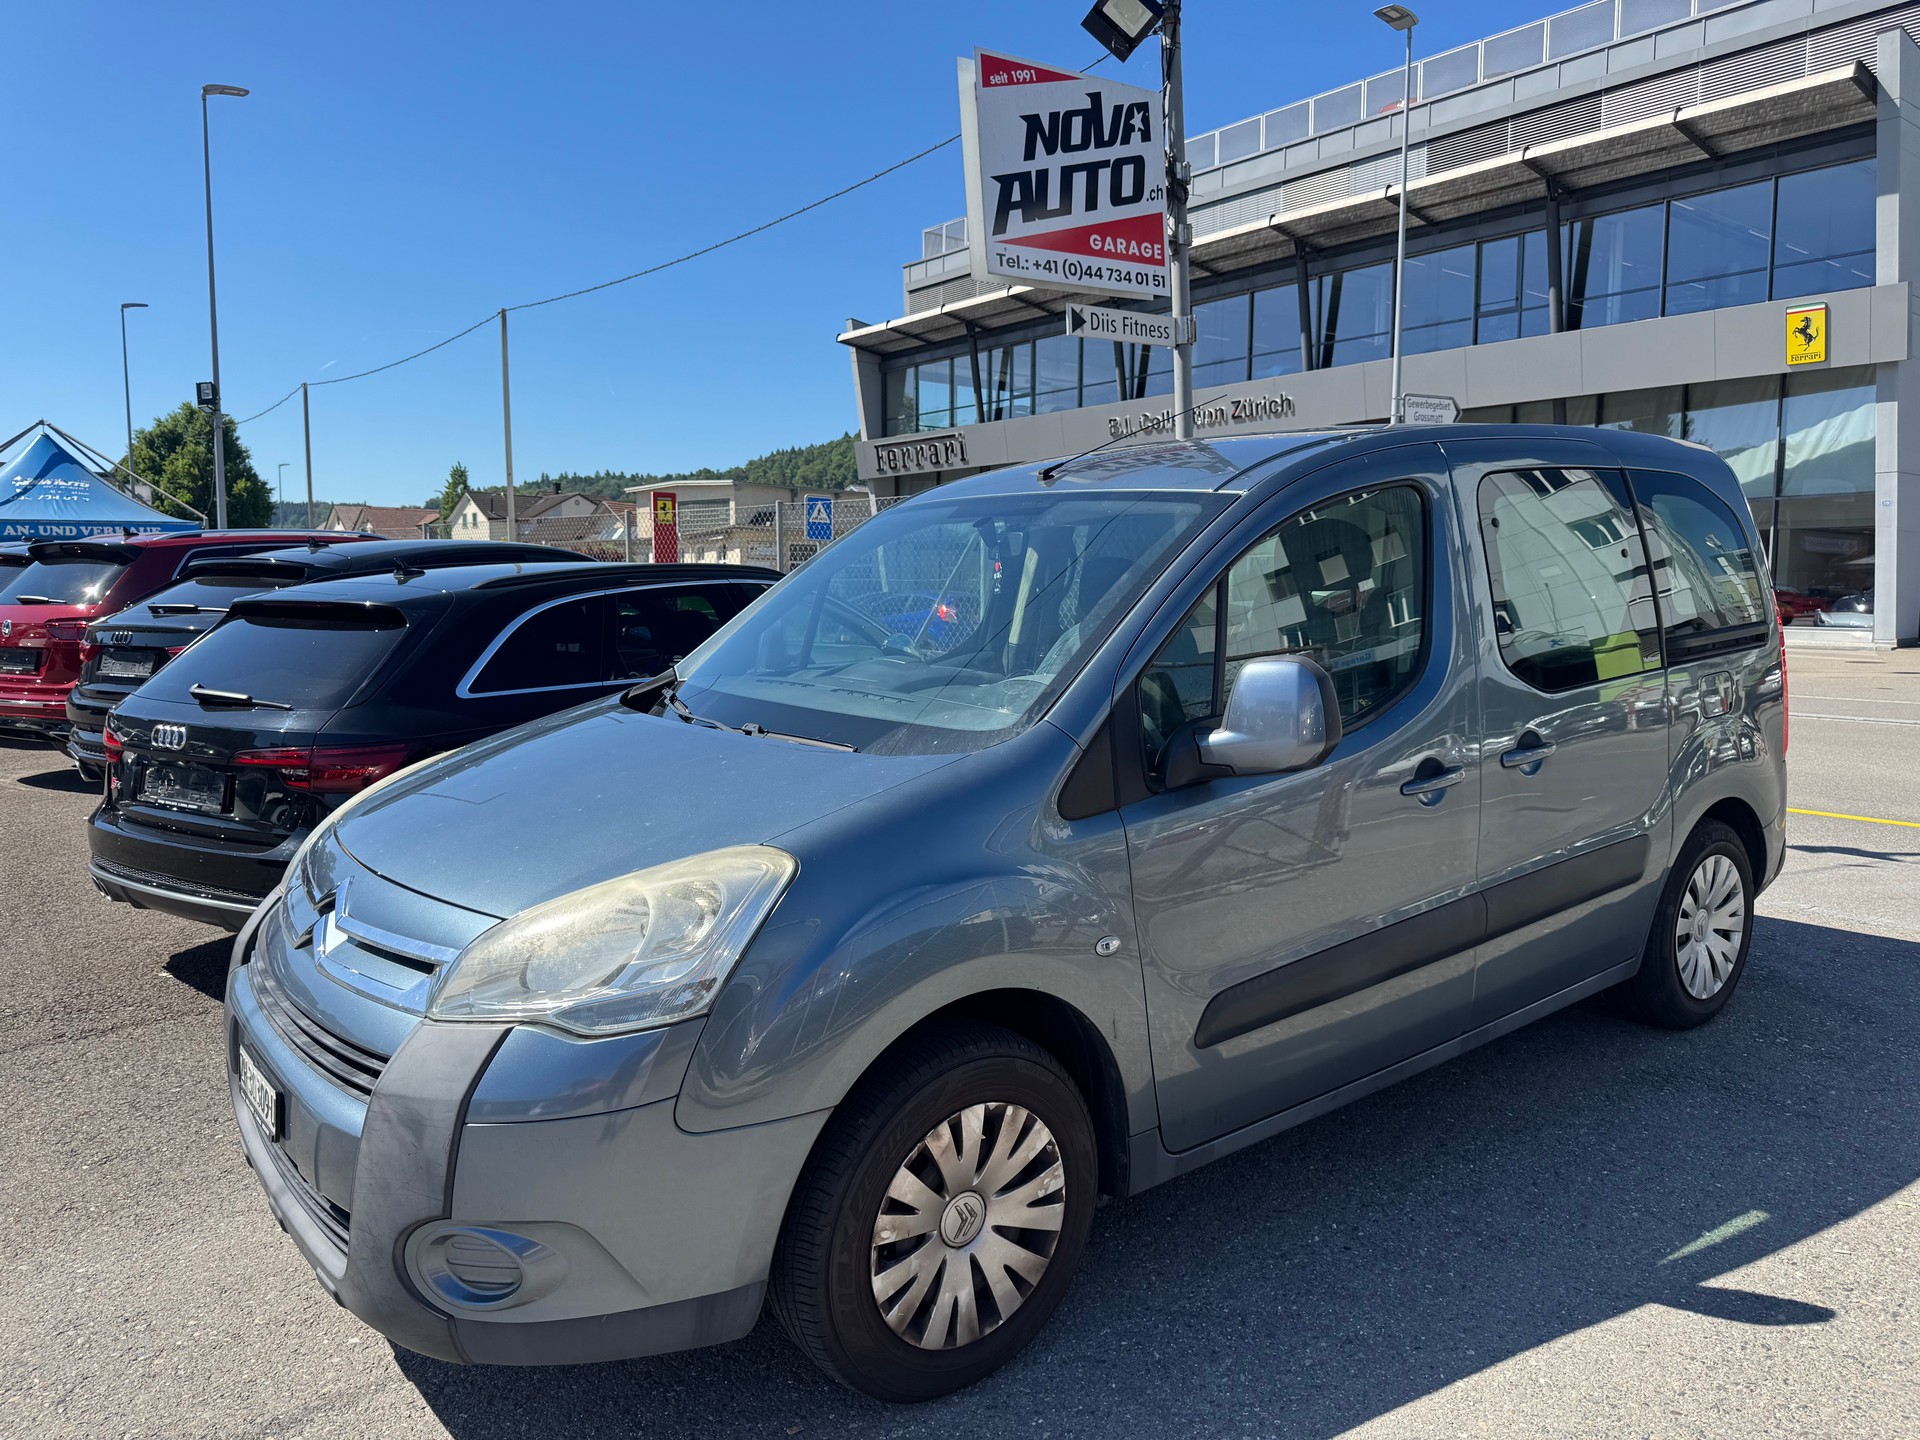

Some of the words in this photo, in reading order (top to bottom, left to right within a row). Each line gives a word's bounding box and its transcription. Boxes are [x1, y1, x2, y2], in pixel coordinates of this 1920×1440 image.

[990, 72, 1008, 85] seit
[1011, 70, 1037, 82] 1991
[1019, 91, 1152, 161] NOVA
[1089, 233, 1162, 260] GARAGE
[996, 252, 1030, 271] Tel.:
[1032, 258, 1059, 274] +41
[1106, 267, 1133, 283] 734
[1135, 272, 1149, 287] 01
[1152, 273, 1166, 289] 51
[1090, 312, 1117, 333] Diis
[1122, 317, 1170, 340] Fitness
[1790, 352, 1821, 362] Ferrari
[1231, 392, 1294, 420] Zürich
[1407, 398, 1451, 412] Gewerbegebiet
[874, 431, 968, 472] Ferrari
[3, 525, 35, 536] AN-
[38, 526, 78, 537] UND
